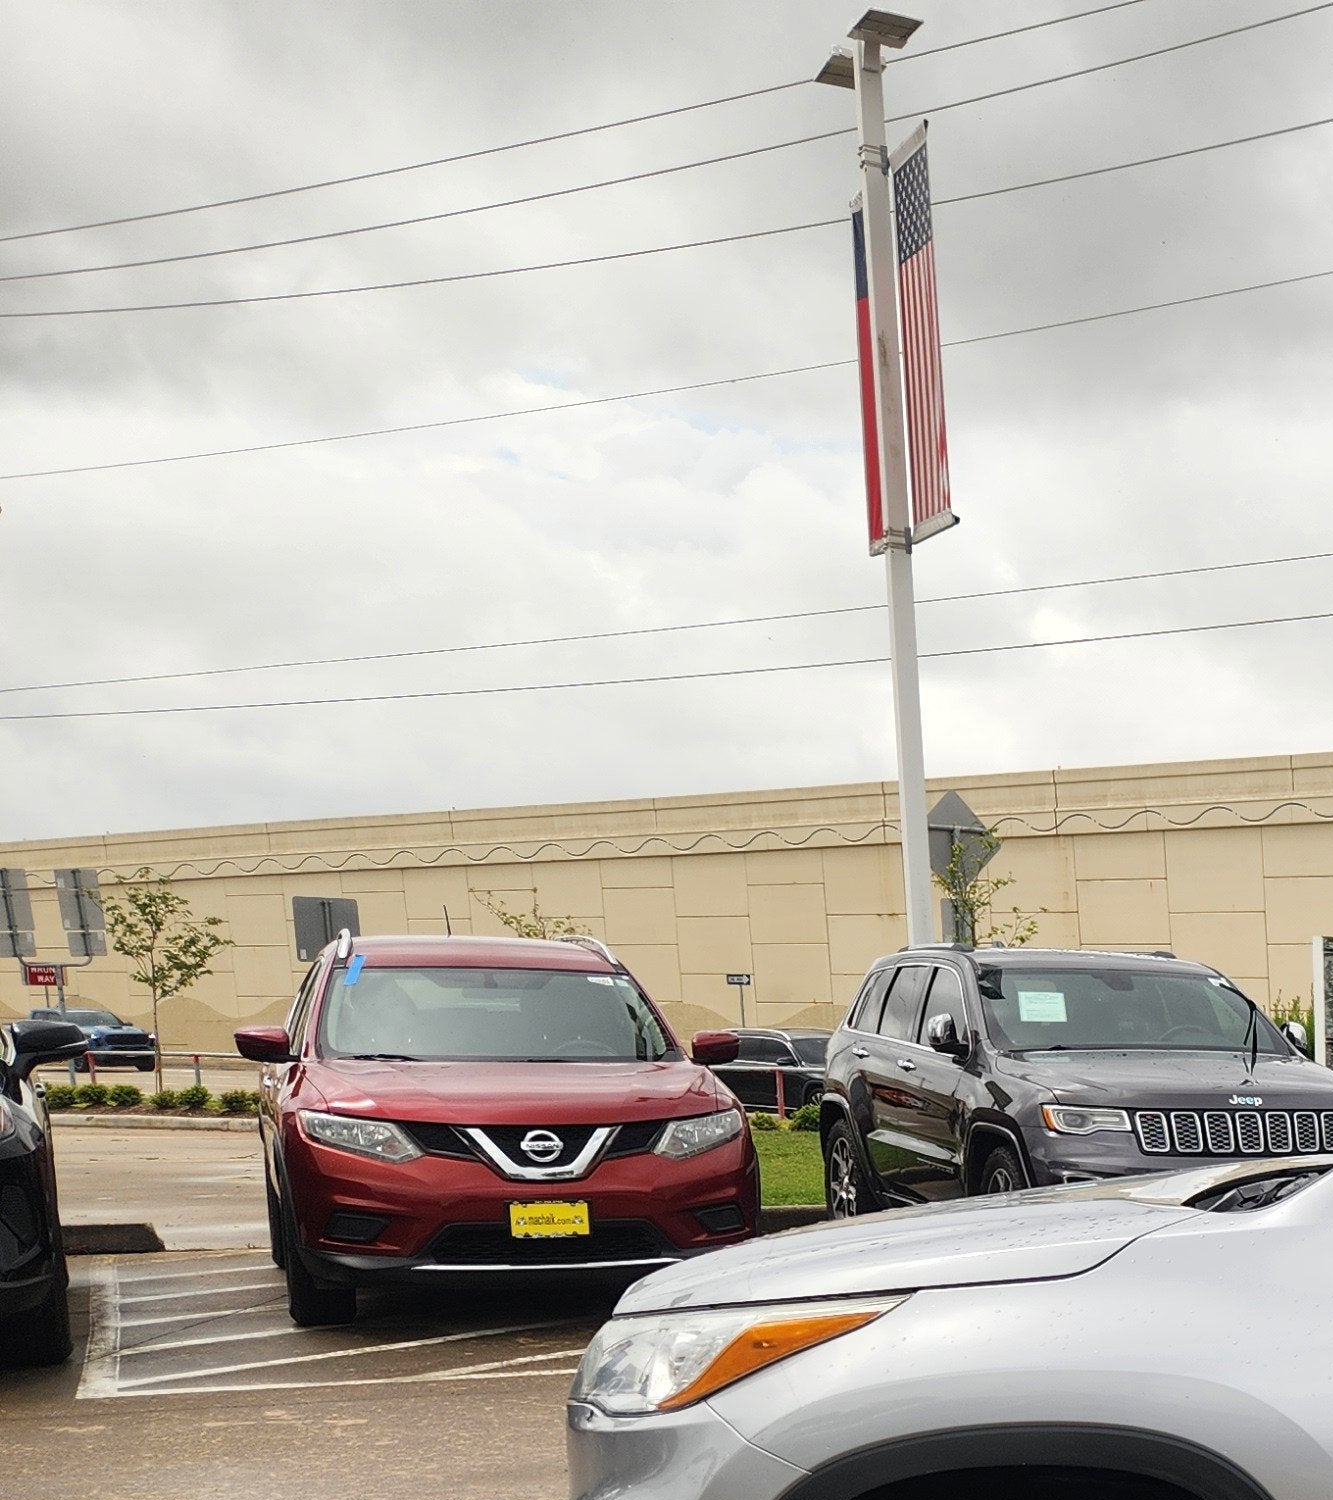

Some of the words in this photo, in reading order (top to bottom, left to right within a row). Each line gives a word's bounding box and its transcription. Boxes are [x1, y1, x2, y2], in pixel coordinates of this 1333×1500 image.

[36, 975, 55, 983] WAY
[1228, 1094, 1263, 1107] Jeep
[525, 1142, 560, 1150] NISSAN
